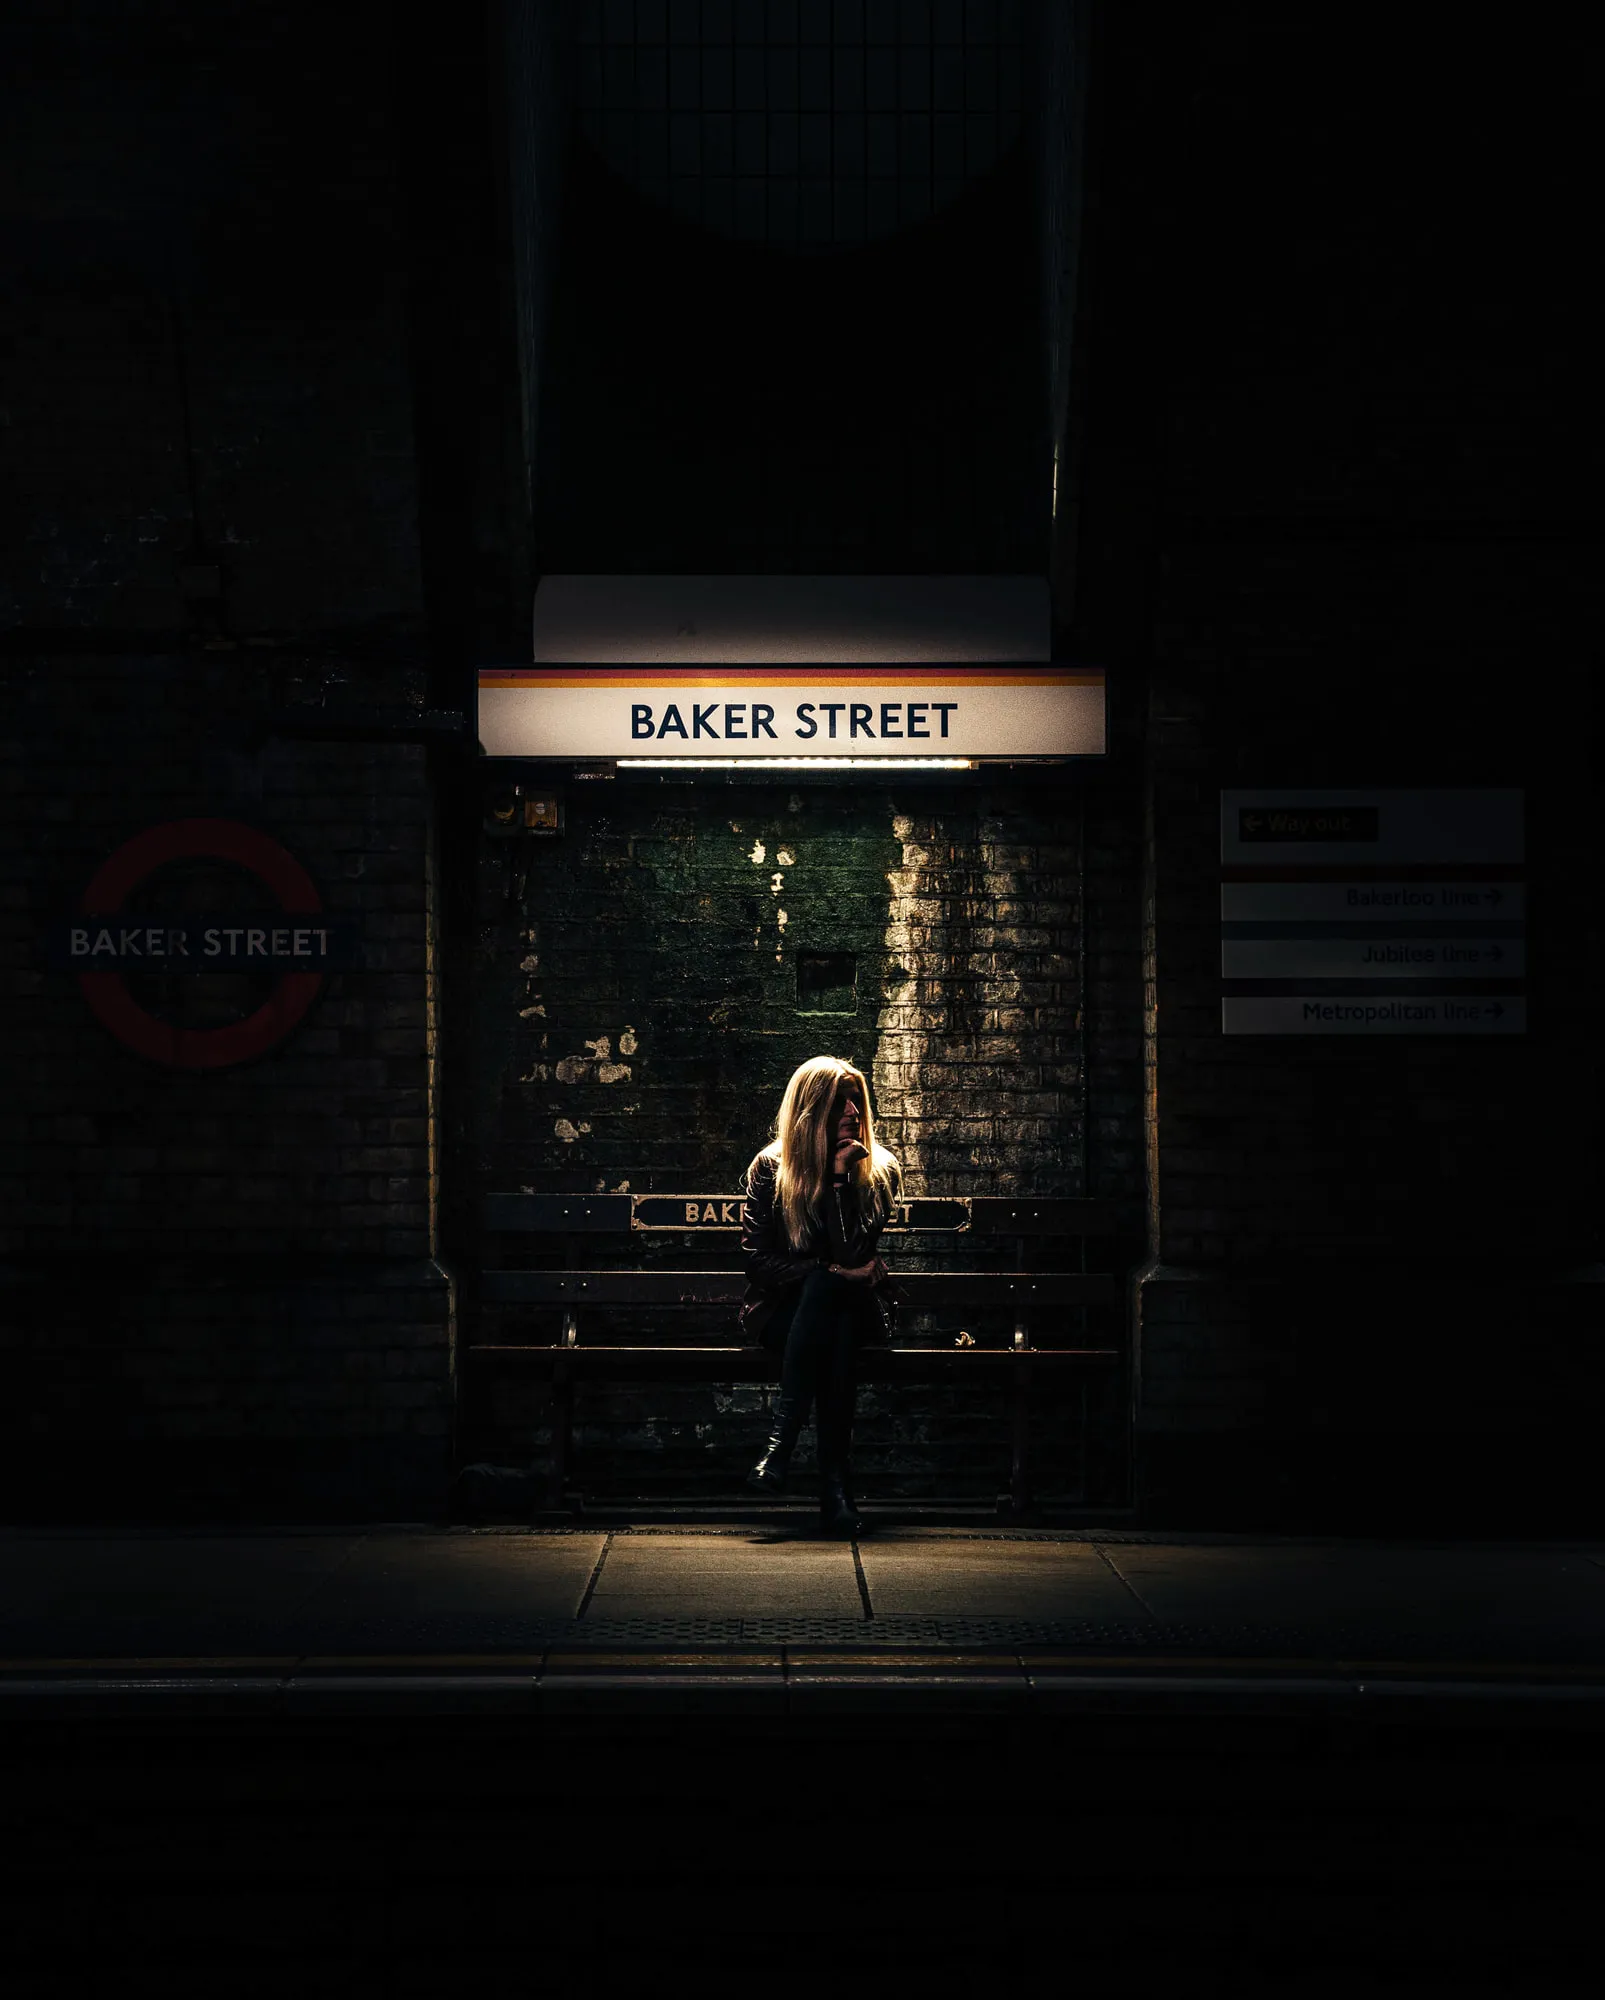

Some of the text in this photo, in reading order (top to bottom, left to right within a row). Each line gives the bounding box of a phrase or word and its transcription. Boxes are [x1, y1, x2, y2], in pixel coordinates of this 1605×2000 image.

[631, 703, 957, 739] BAKER STREET
[1268, 813, 1352, 834] Way out
[1347, 889, 1479, 906] Bakerloo line
[70, 928, 330, 956] BAKER STREET
[1362, 945, 1479, 964] Jubilee line
[1303, 1003, 1480, 1024] Metropolitan line
